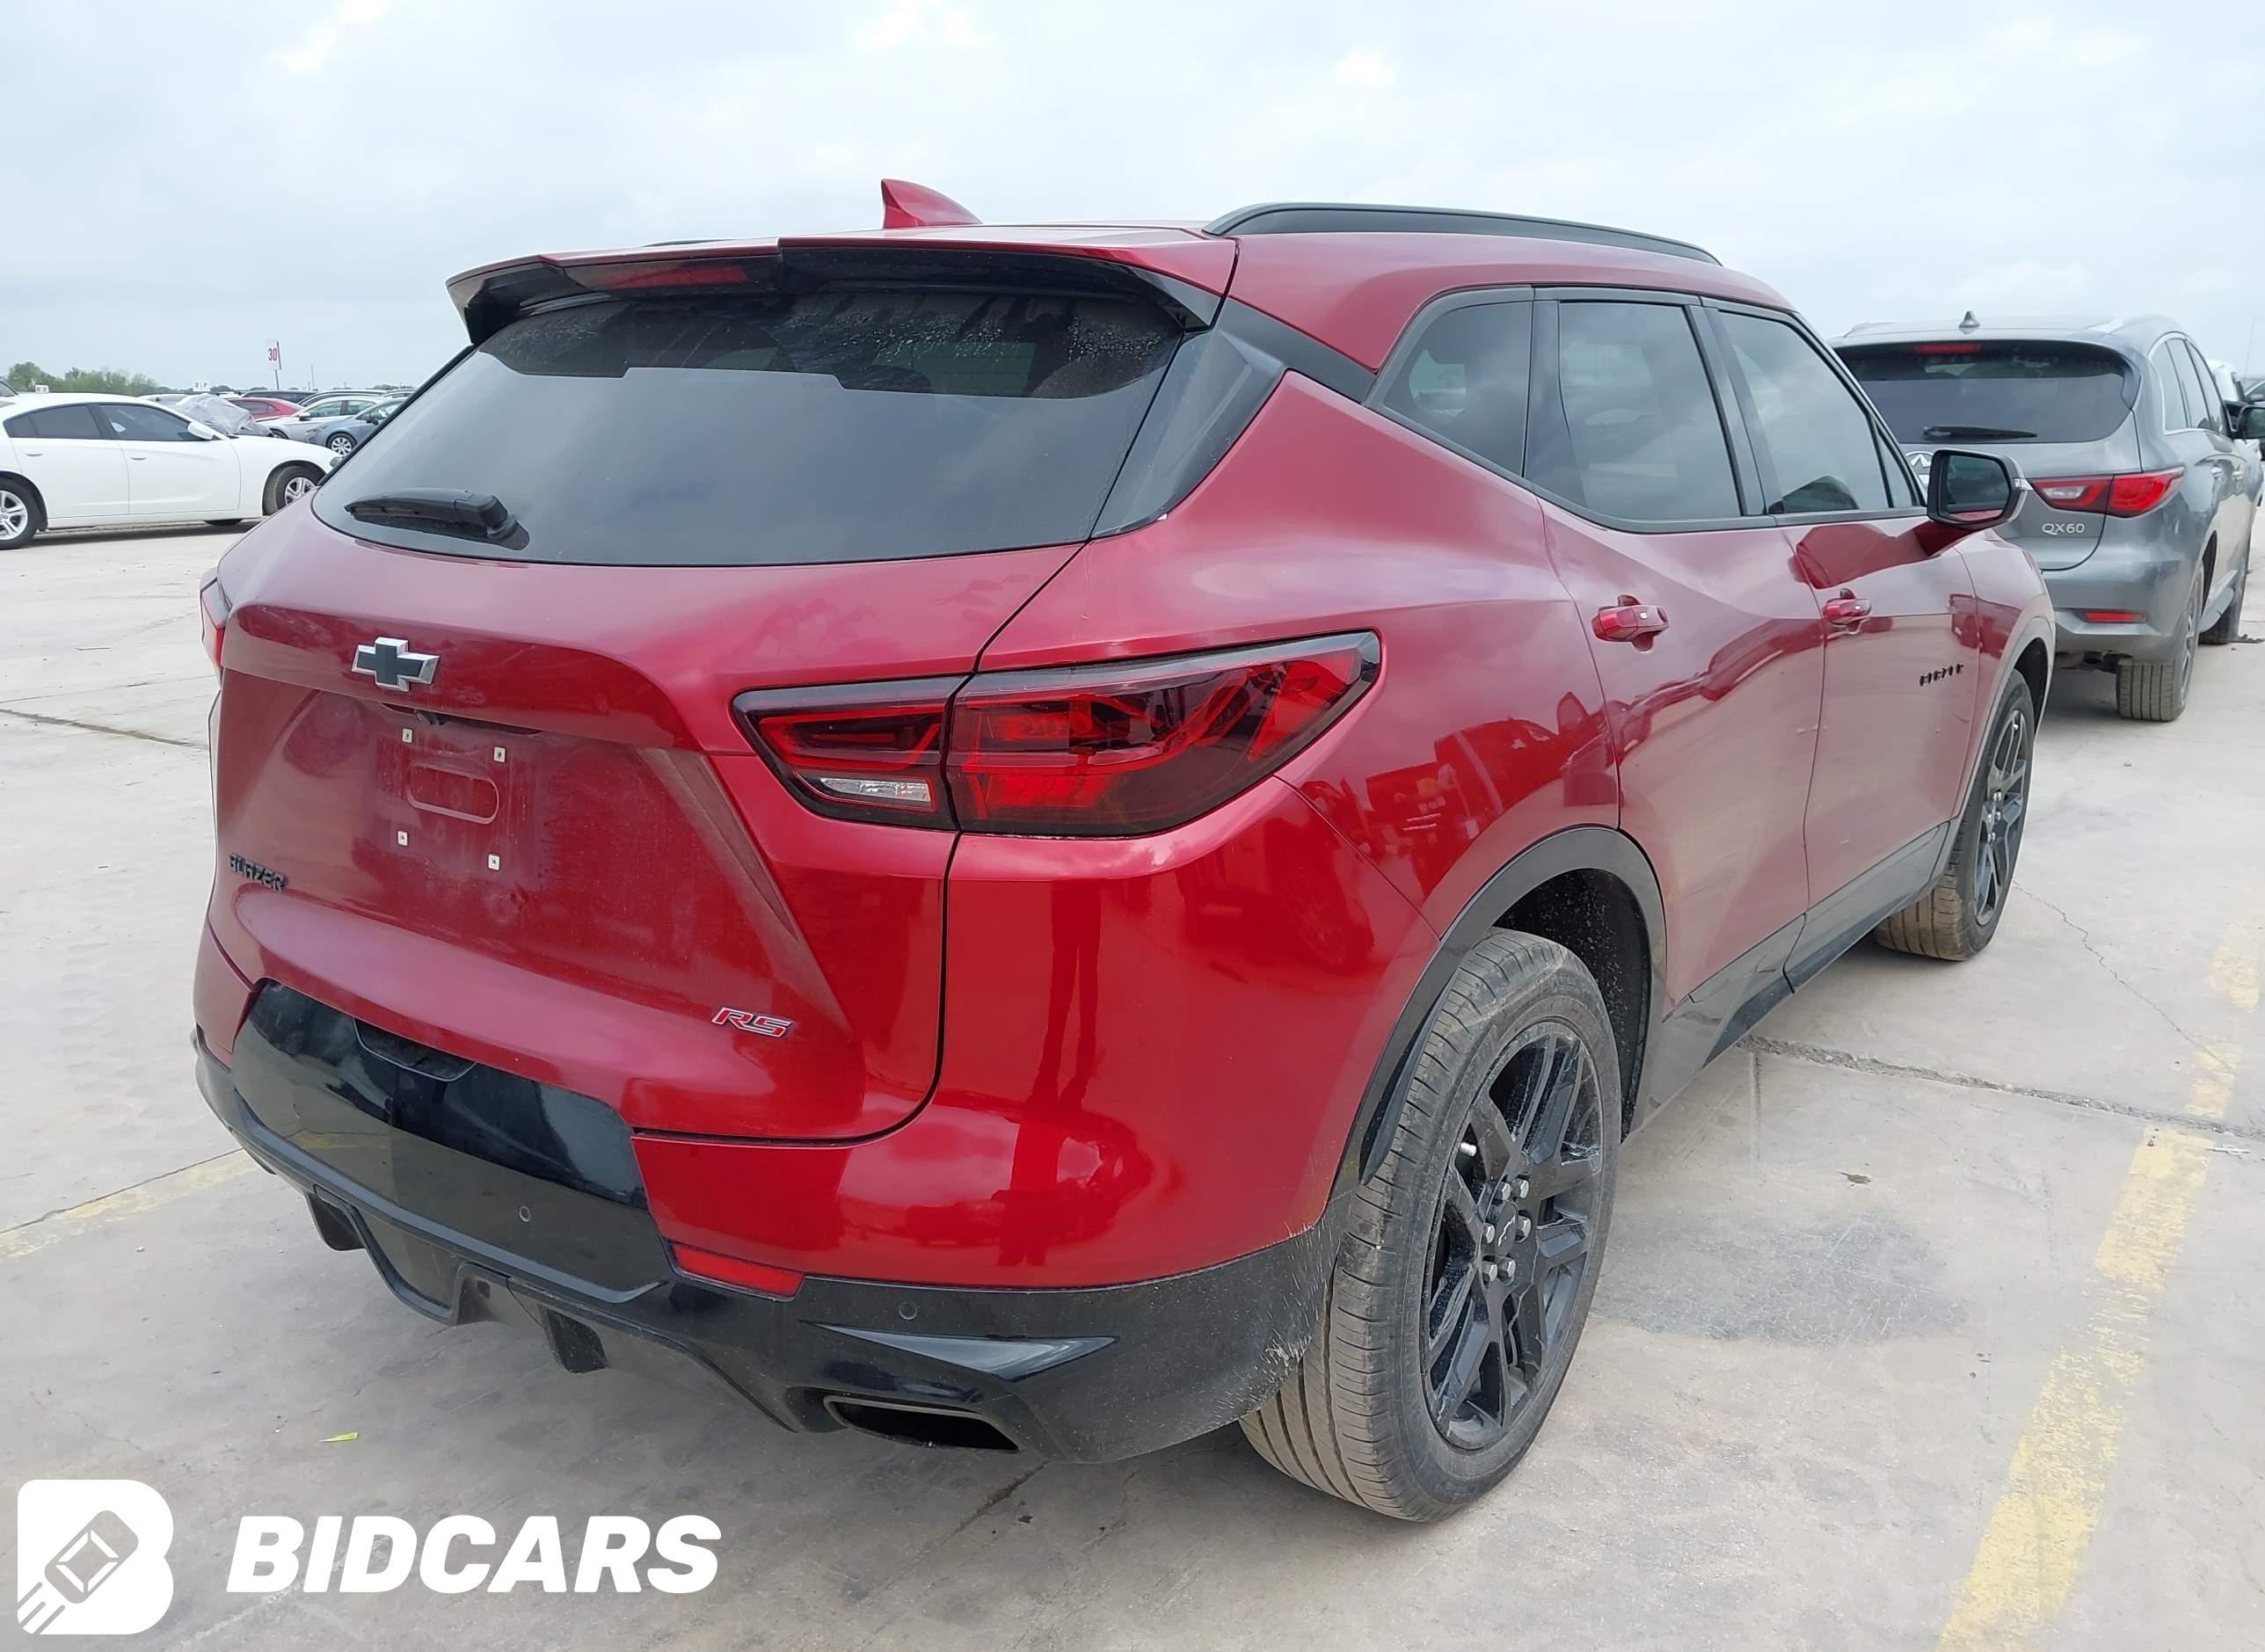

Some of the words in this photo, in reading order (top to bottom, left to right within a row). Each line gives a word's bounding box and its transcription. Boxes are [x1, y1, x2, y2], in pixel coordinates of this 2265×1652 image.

[267, 347, 278, 361] 30
[2042, 523, 2086, 535] QX60
[710, 1006, 793, 1038] RS
